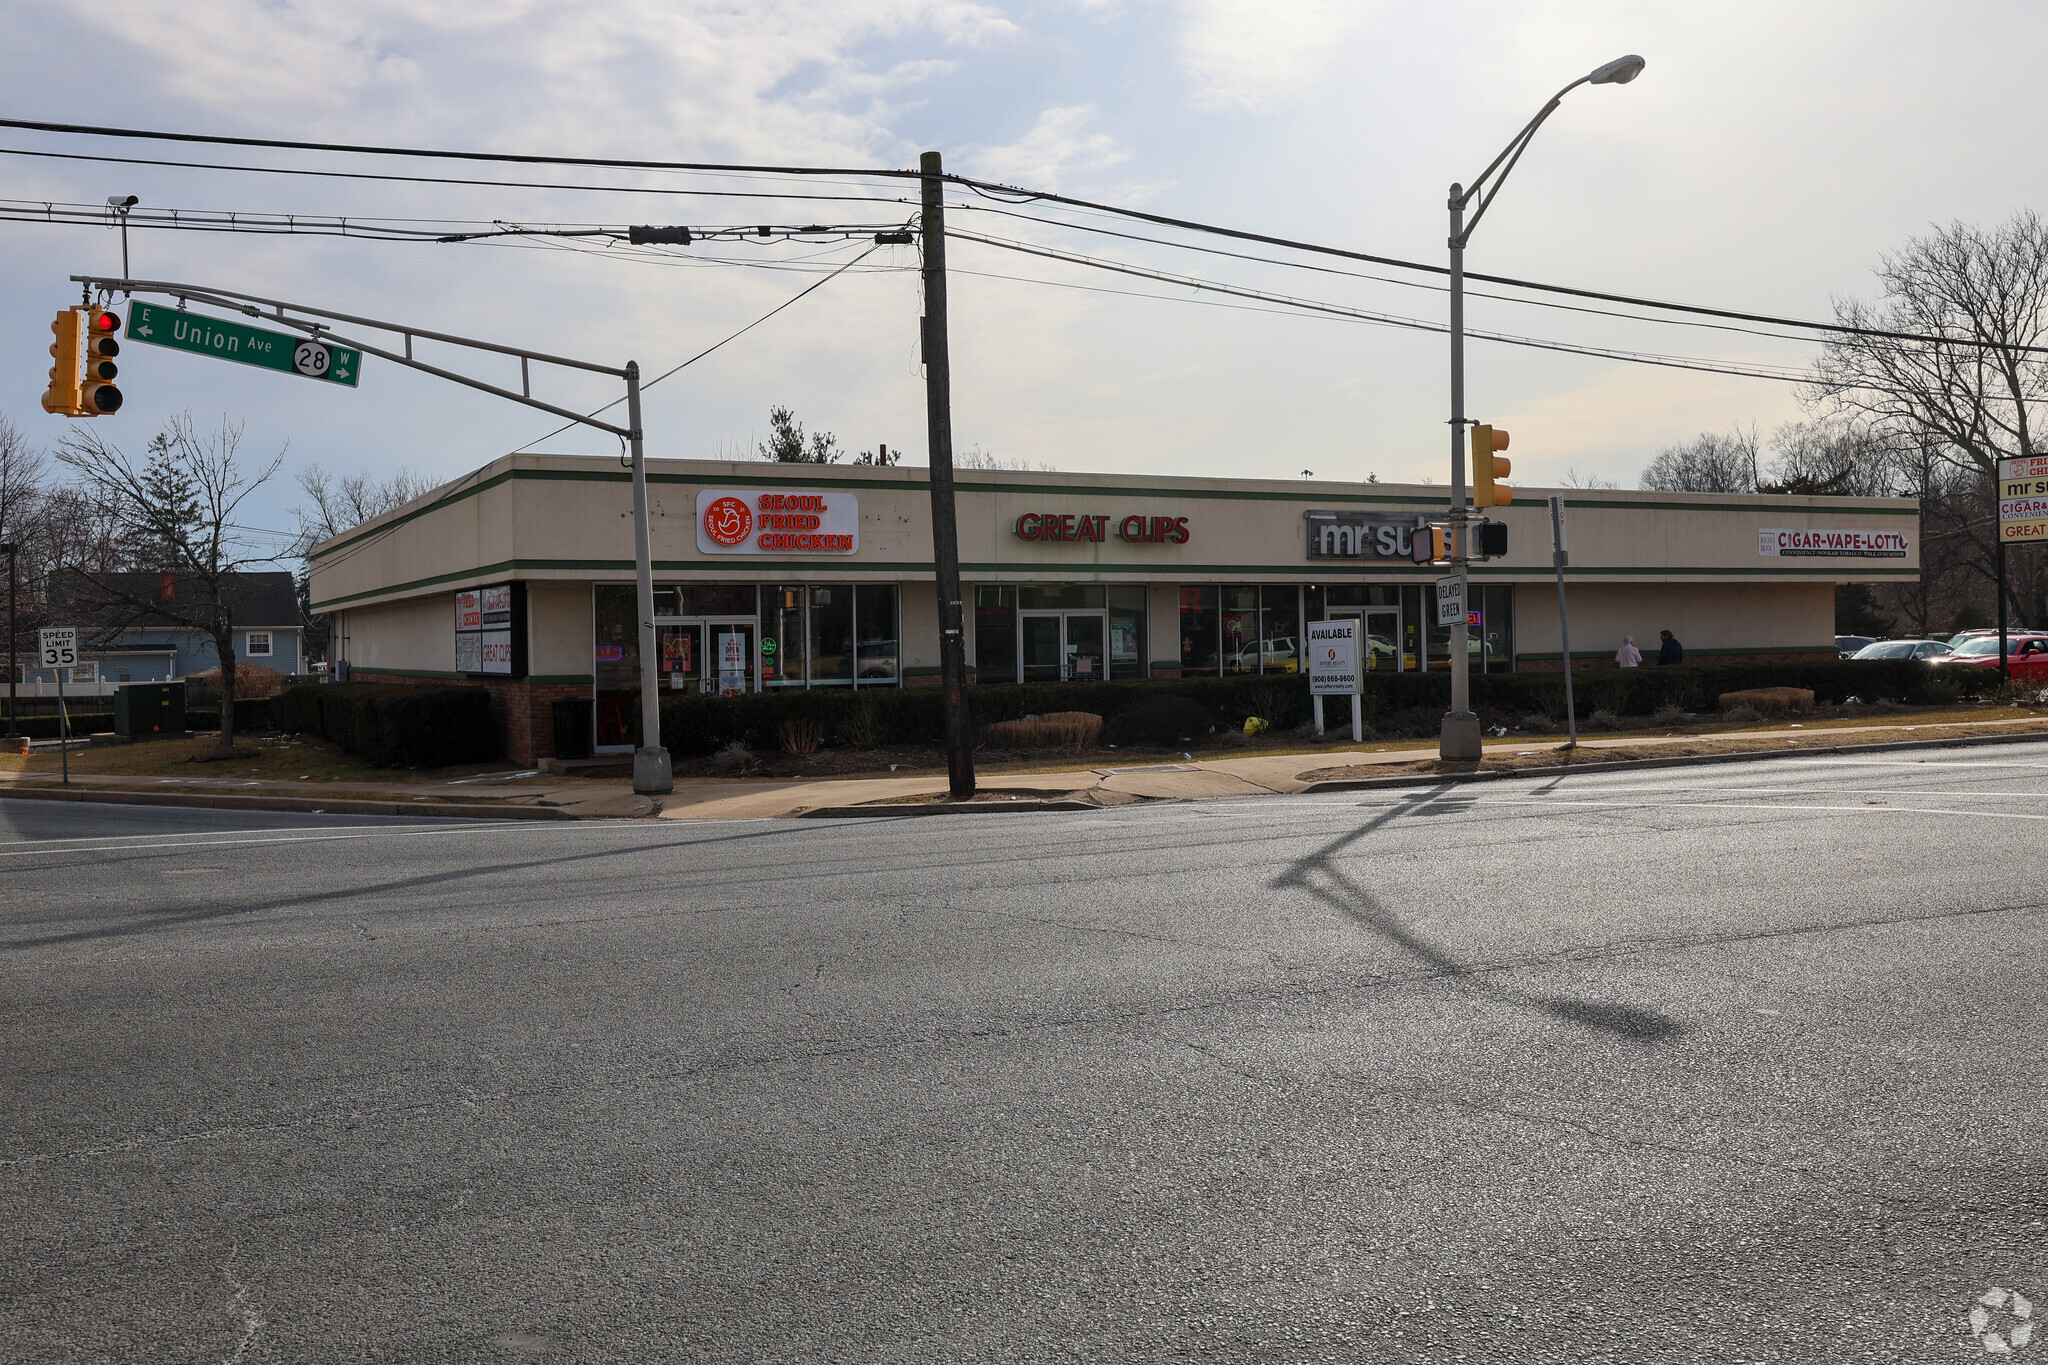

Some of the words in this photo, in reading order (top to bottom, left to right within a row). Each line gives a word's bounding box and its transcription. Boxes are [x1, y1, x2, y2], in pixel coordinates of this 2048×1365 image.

[142, 309, 151, 322] E
[173, 320, 239, 352] Union
[247, 337, 272, 353] Ave
[297, 347, 325, 371] 28
[339, 352, 351, 366] W
[2008, 482, 2031, 496] mr
[2035, 481, 2048, 493] s
[758, 494, 828, 511] SEOUL
[708, 515, 717, 537] SEOUL
[716, 535, 736, 544] FRIED
[735, 515, 751, 542] CHICKEN
[758, 514, 821, 530] FRIED
[1016, 512, 1111, 543] GREAT
[1120, 515, 1190, 544] CLIPS
[2005, 523, 2047, 537] GREAT
[758, 533, 854, 551] CHICKEN
[1320, 525, 1370, 555] mr
[1439, 583, 1461, 599] DELAYED
[1442, 602, 1460, 617] GREEN
[43, 631, 74, 639] SPEED
[1311, 628, 1353, 640] AVAILABLE
[46, 640, 71, 648] LIMIT
[45, 648, 75, 664] 35
[484, 643, 498, 662] GREAT
